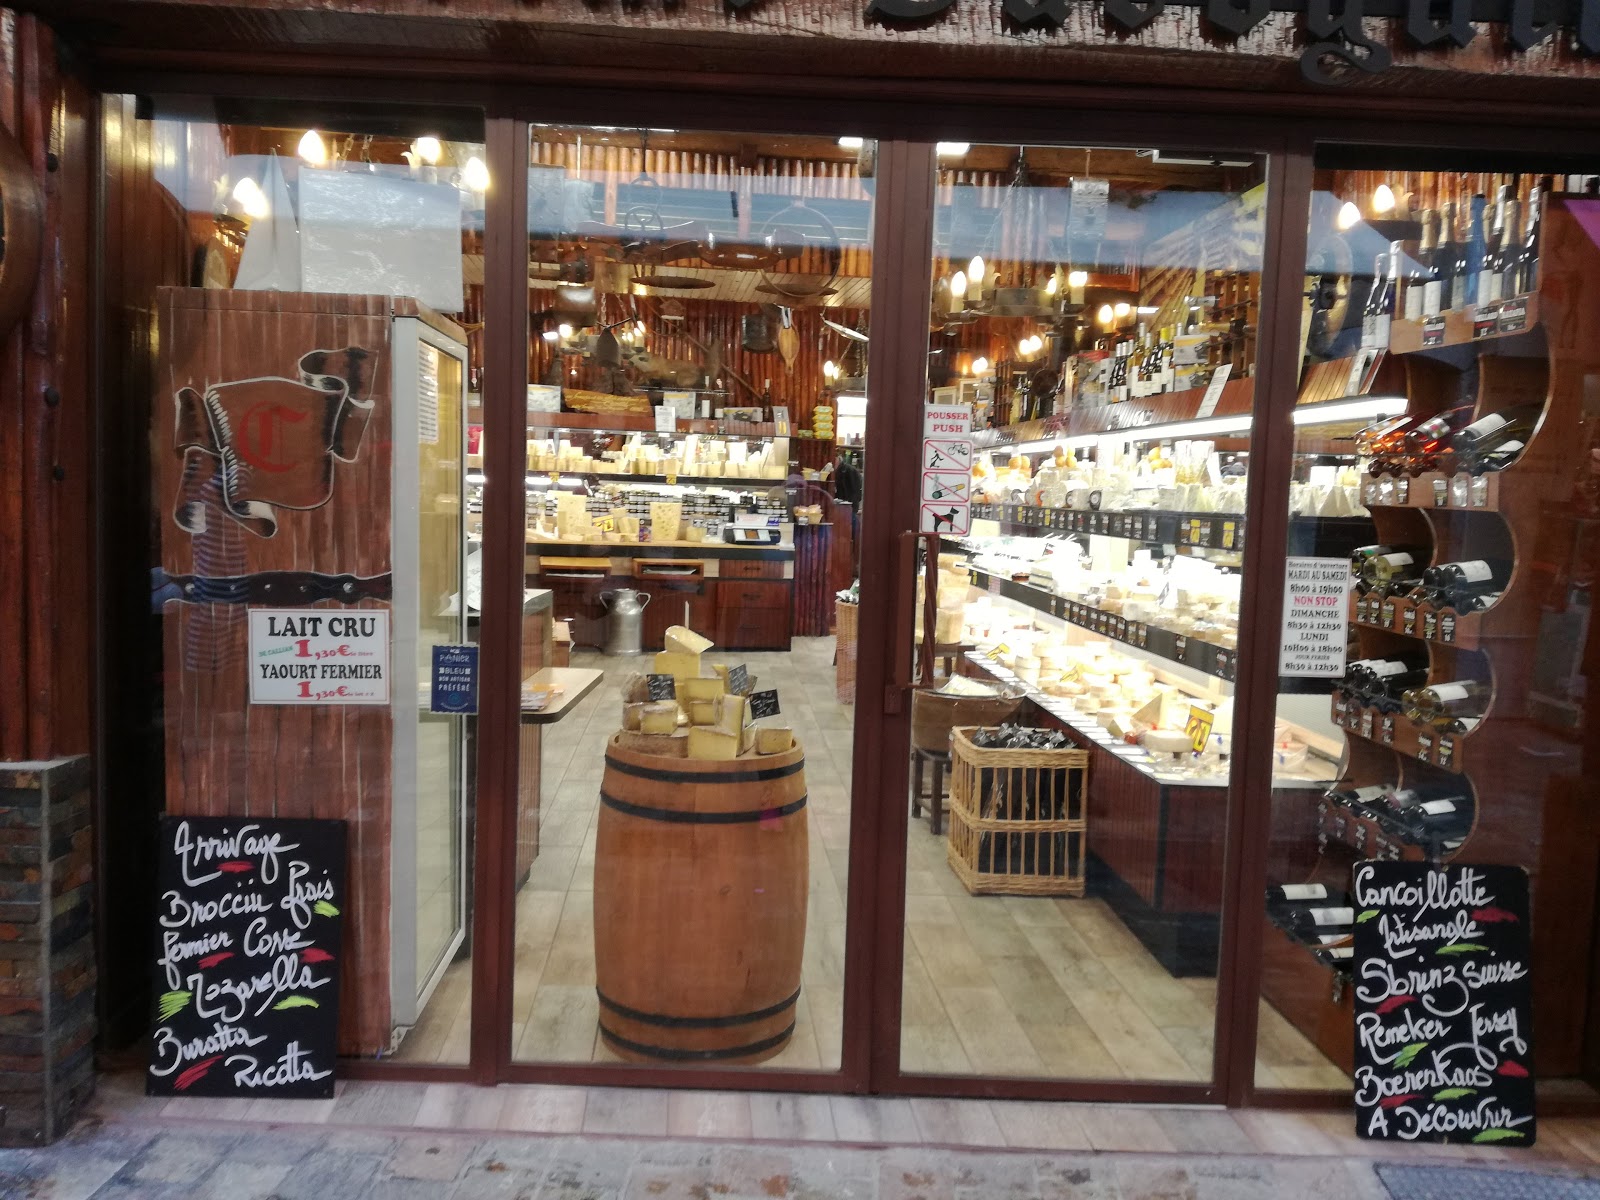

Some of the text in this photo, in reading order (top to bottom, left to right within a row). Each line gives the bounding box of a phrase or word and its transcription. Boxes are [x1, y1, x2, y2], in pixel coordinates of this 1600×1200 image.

[927, 411, 968, 420] POUSSER
[932, 424, 964, 433] PUSH
[1288, 570, 1348, 580] MARDI AU SAMEDI
[1290, 584, 1343, 594] 8h00 à 19h00
[1294, 596, 1338, 606] NON STOP
[1290, 610, 1340, 618] DIMANCHE
[268, 616, 376, 637] LAIT CRU
[1287, 621, 1342, 630] 8h30 à 12h30
[1300, 632, 1329, 641] LUNDI
[1310, 644, 1316, 652] à
[1318, 645, 1342, 653] 18h00
[260, 664, 382, 680] YAOURT FERMIER
[1285, 662, 1339, 672] 8h30 à 12h30
[1368, 1106, 1389, 1137] A
